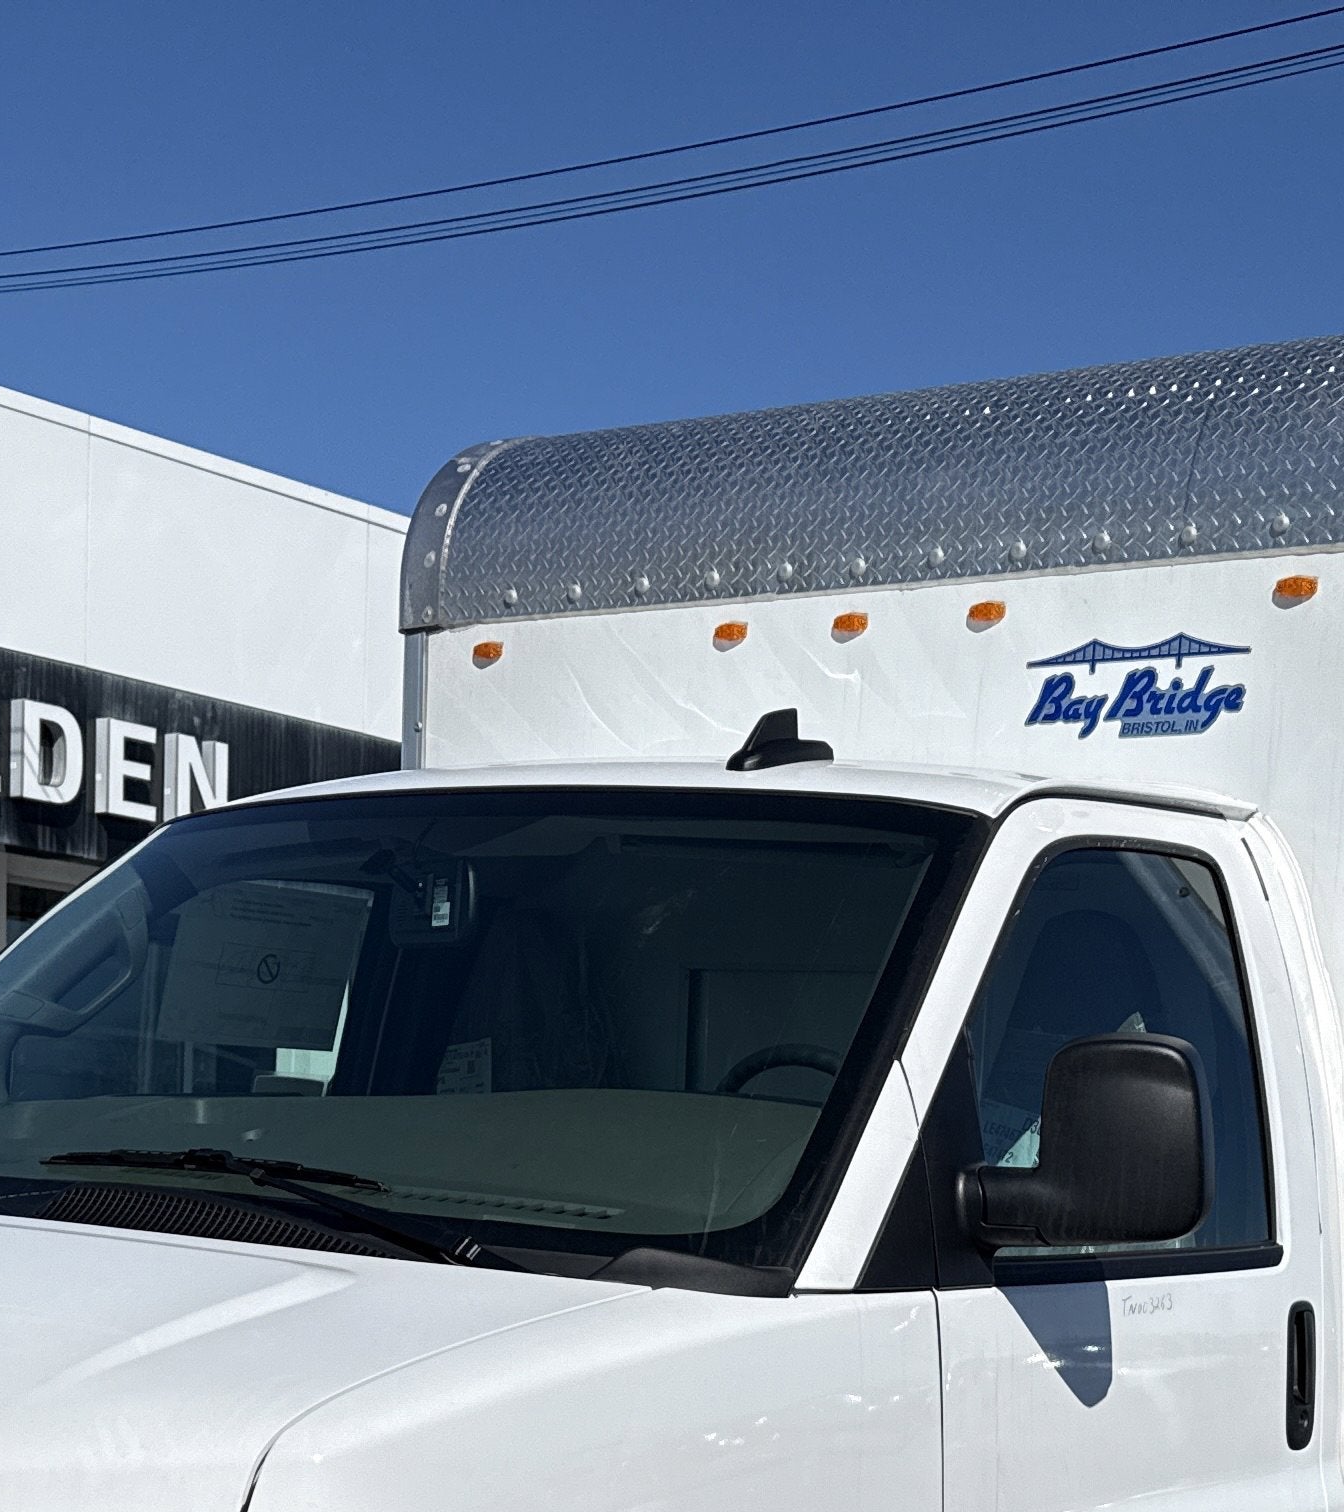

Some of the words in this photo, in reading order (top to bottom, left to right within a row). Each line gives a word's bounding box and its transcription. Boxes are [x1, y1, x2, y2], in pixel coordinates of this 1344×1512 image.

[1024, 672, 1108, 740] Bay
[1104, 665, 1246, 731] Bridge
[1121, 721, 1183, 735] BRISTOL,
[1184, 719, 1200, 732] IN
